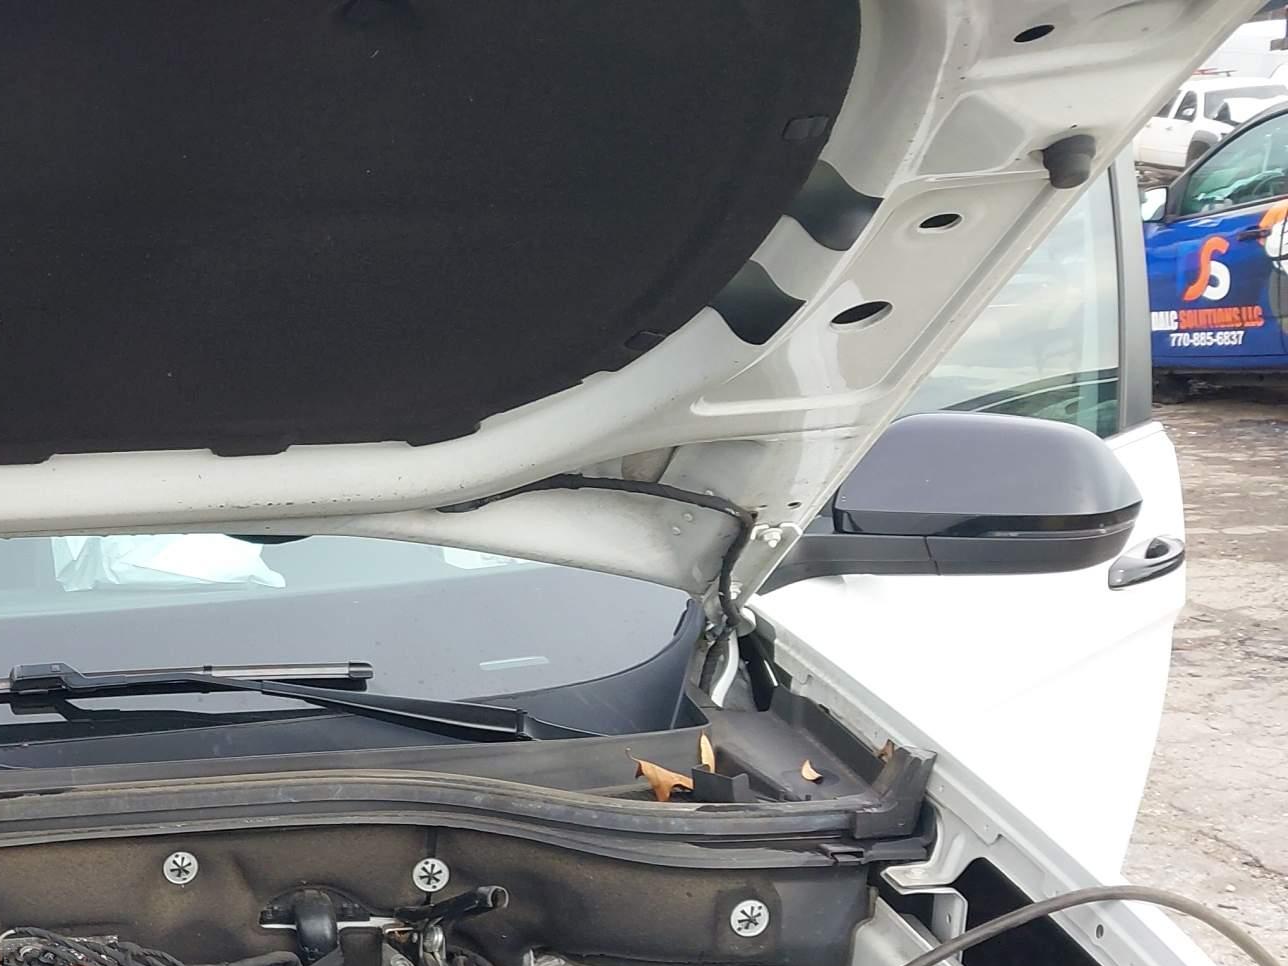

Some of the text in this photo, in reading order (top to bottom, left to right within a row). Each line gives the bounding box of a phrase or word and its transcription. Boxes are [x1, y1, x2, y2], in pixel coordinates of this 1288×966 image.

[1179, 307, 1242, 329] SOLUTIONS
[1242, 305, 1264, 327] LLC
[1168, 331, 1244, 347] 770-885-6837
